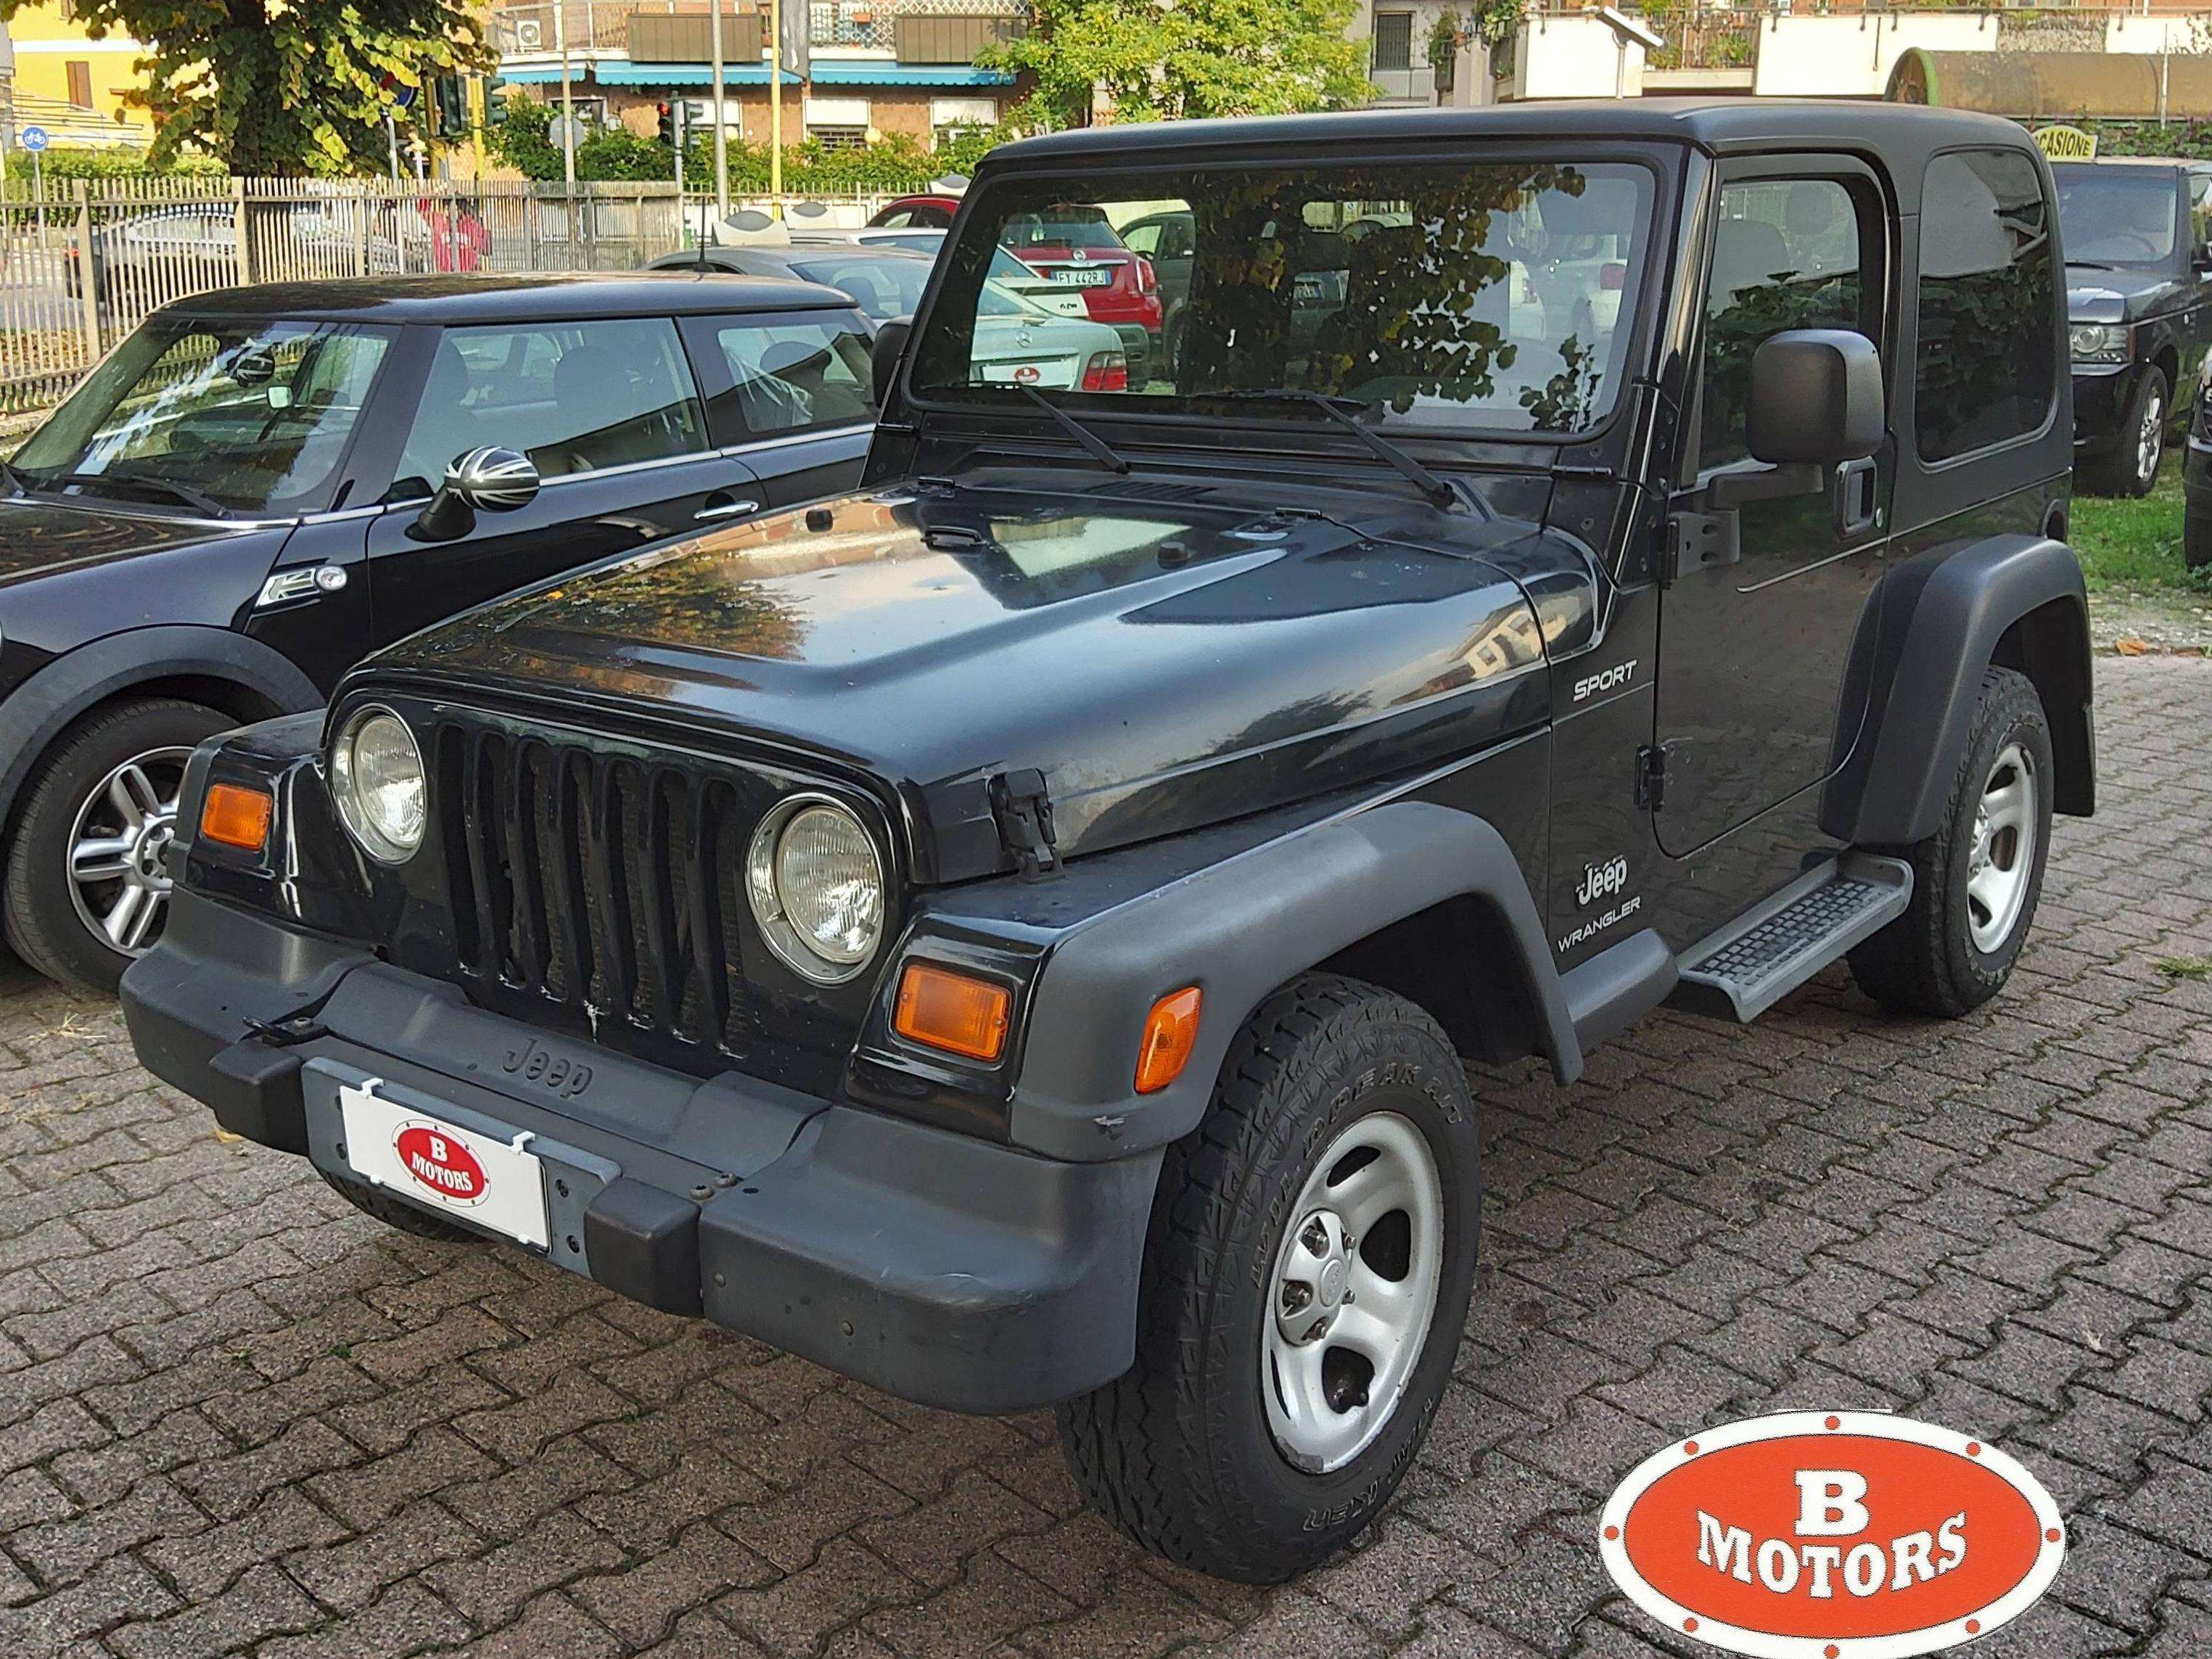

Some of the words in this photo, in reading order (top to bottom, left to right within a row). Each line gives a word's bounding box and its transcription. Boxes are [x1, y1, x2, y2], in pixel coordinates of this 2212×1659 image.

[2035, 131, 2091, 157] CASIONE
[1573, 659, 1637, 702] SPORT
[1576, 855, 1628, 905] Jeep
[1558, 895, 1641, 953] WRANGLER
[502, 1037, 593, 1099] Jeep
[429, 1135, 448, 1163] B
[411, 1150, 474, 1192] MOTORS
